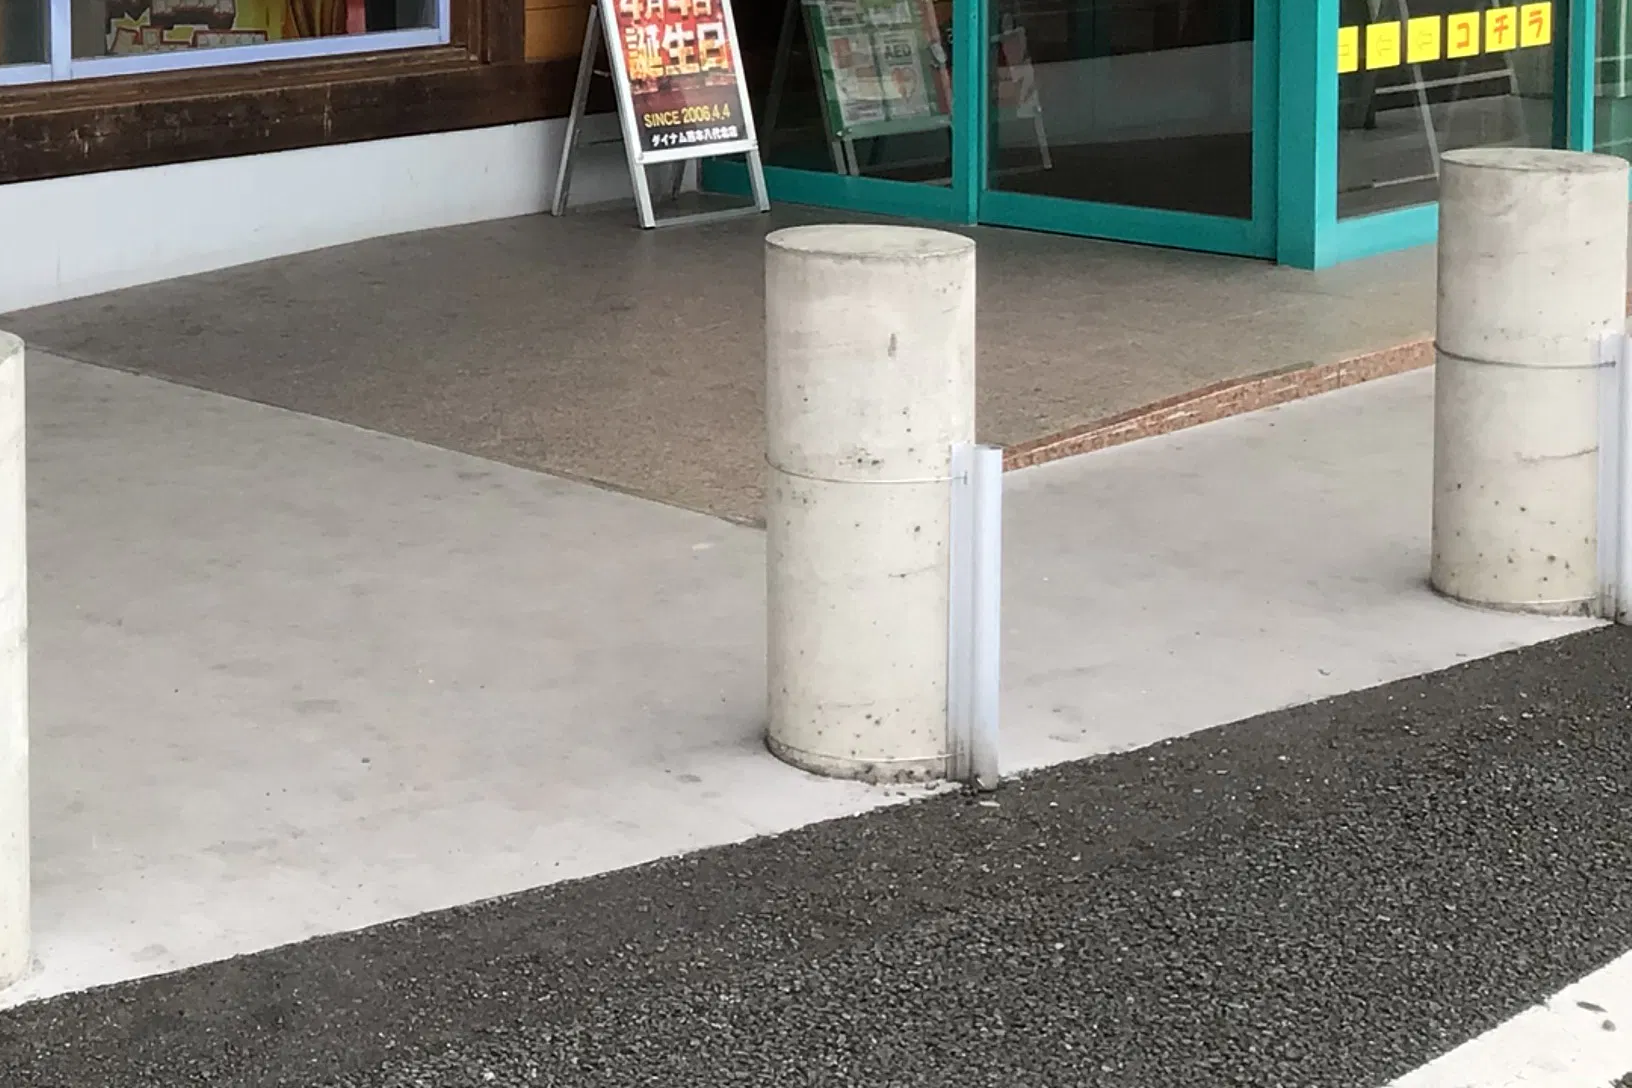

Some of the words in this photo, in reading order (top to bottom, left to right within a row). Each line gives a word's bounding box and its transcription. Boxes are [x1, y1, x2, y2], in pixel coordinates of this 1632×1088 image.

[1457, 10, 1543, 49] コチラ
[624, 21, 729, 80] 誕生日
[643, 110, 681, 128] SINCE
[681, 103, 731, 124] 2006.4.4
